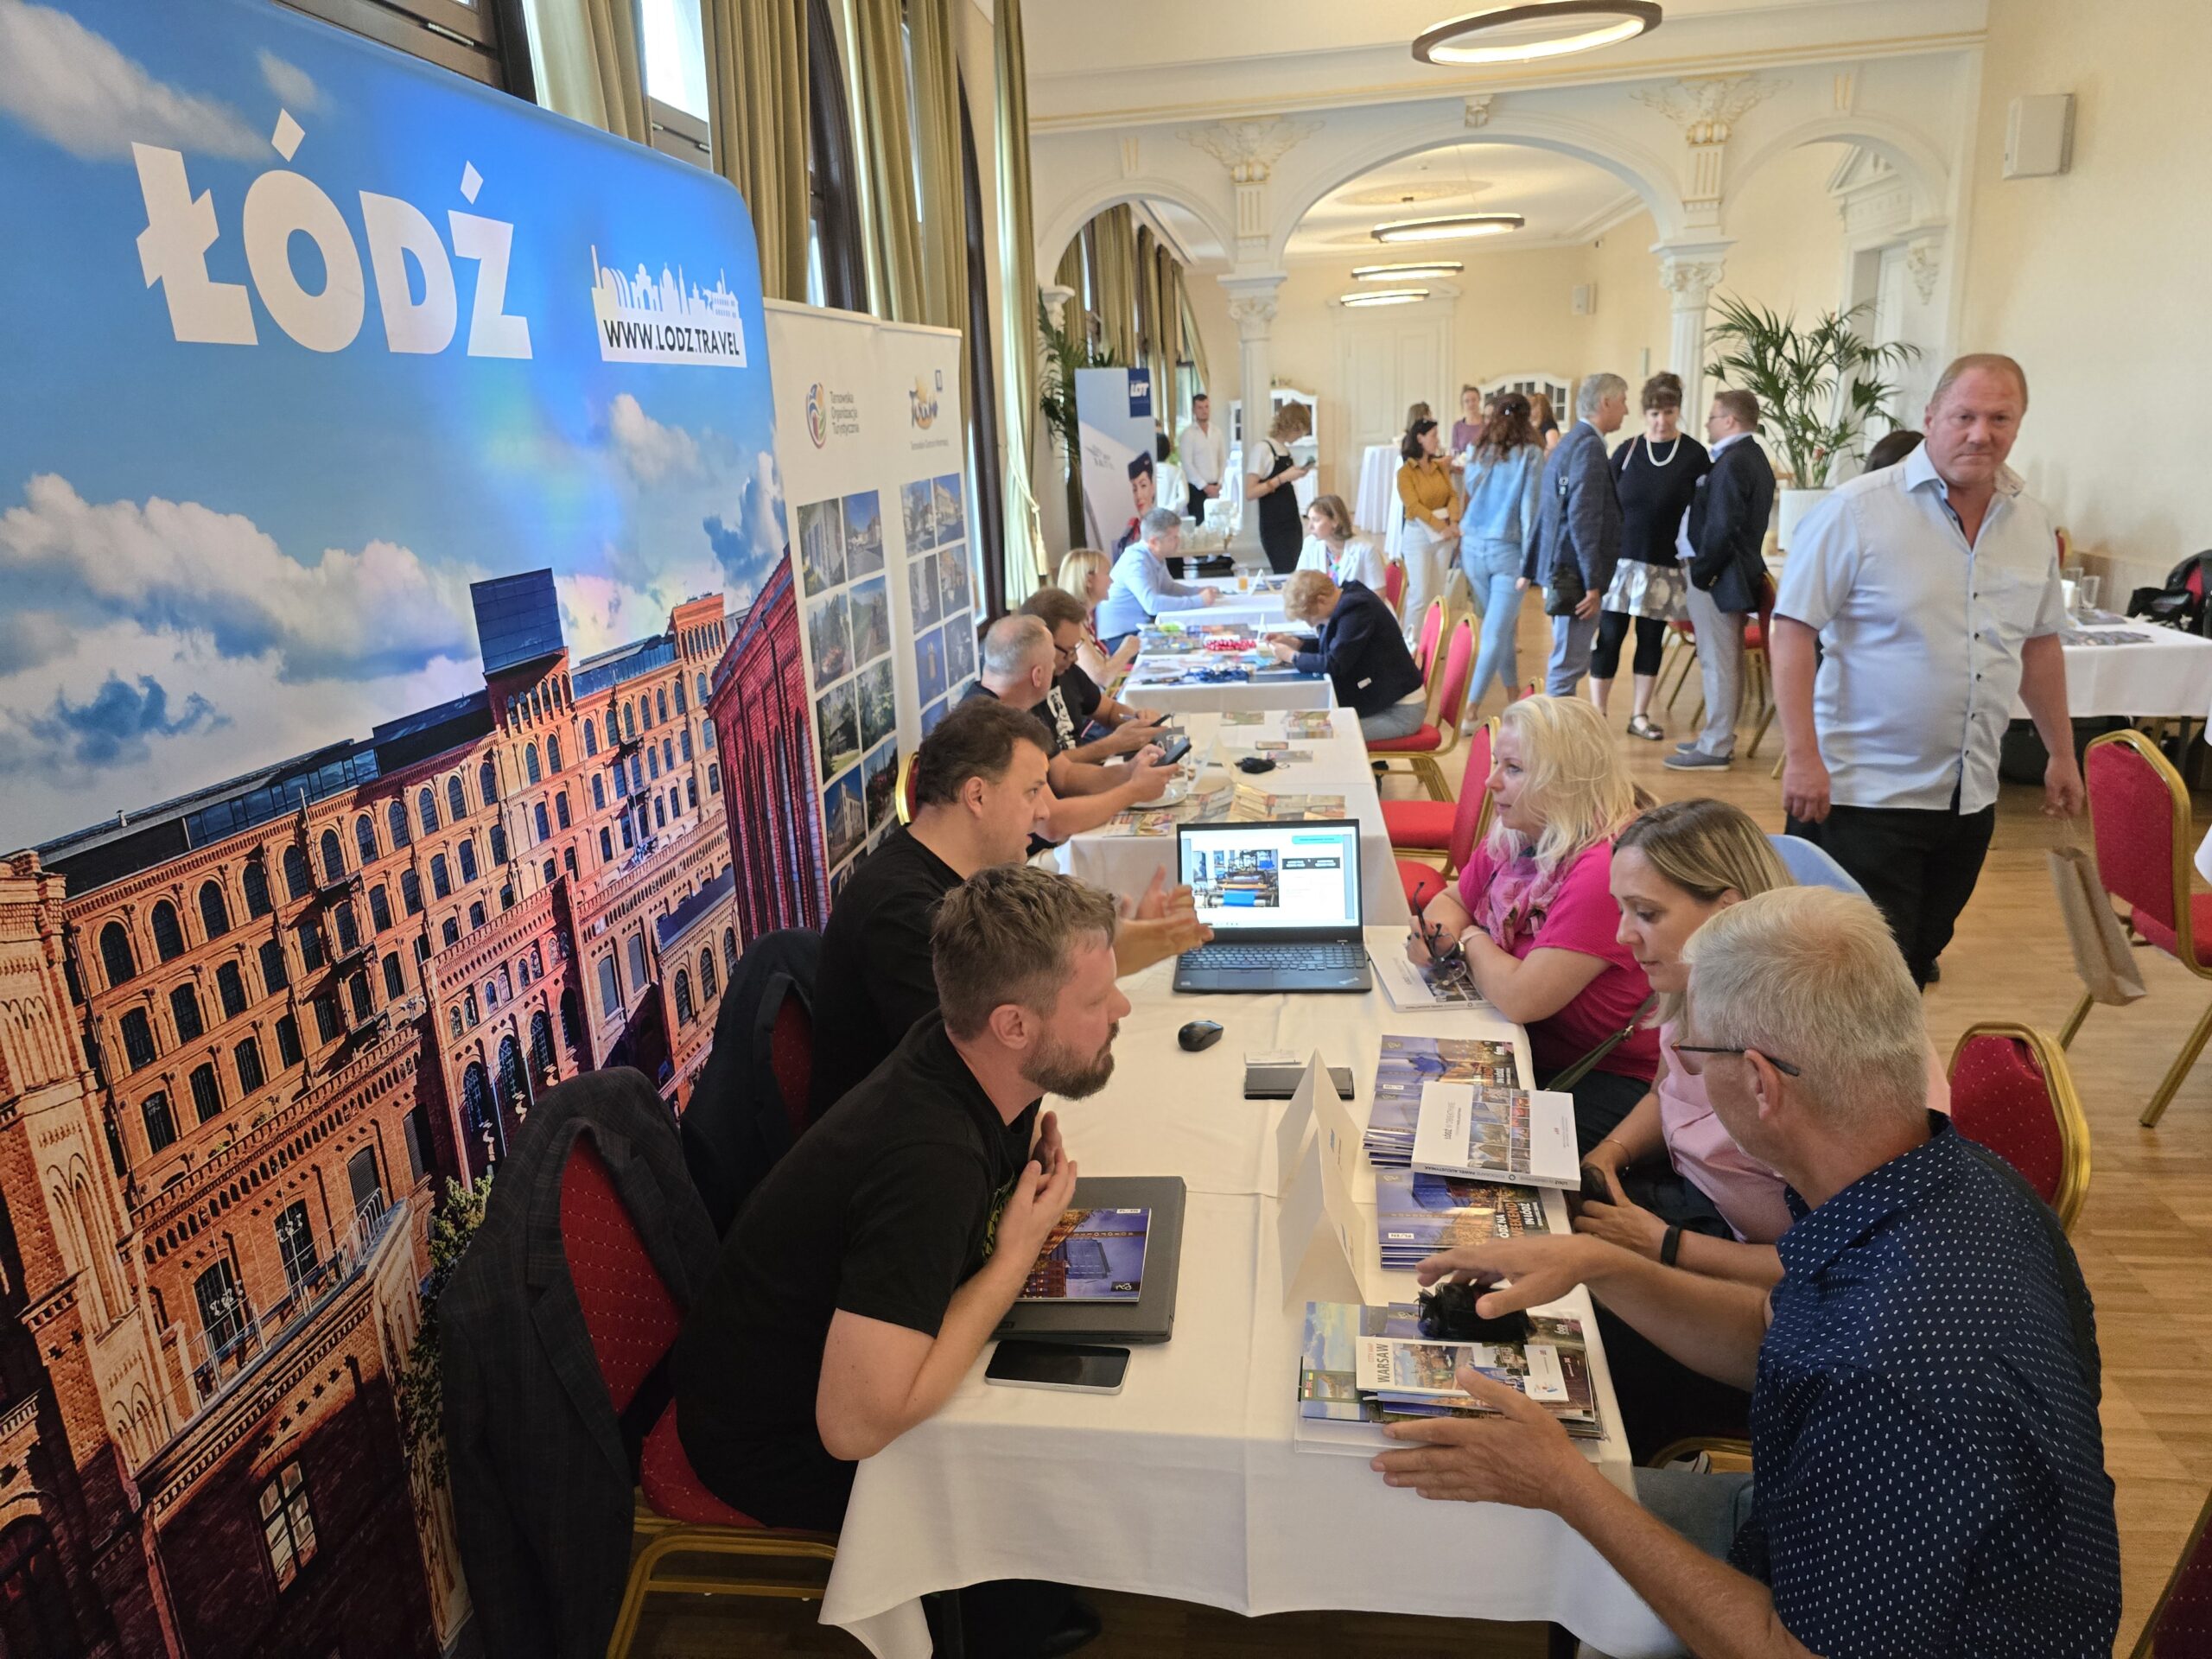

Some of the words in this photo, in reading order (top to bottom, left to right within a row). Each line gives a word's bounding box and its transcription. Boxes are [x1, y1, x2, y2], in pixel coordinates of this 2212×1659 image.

[131, 108, 533, 359] ŁÓDŹ
[603, 319, 740, 356] WWW.LODZ.TRAVEL
[1129, 382, 1149, 397] LOT
[1495, 1224, 1510, 1238] ÓDŹ
[1376, 1343, 1390, 1383] WARSAW
